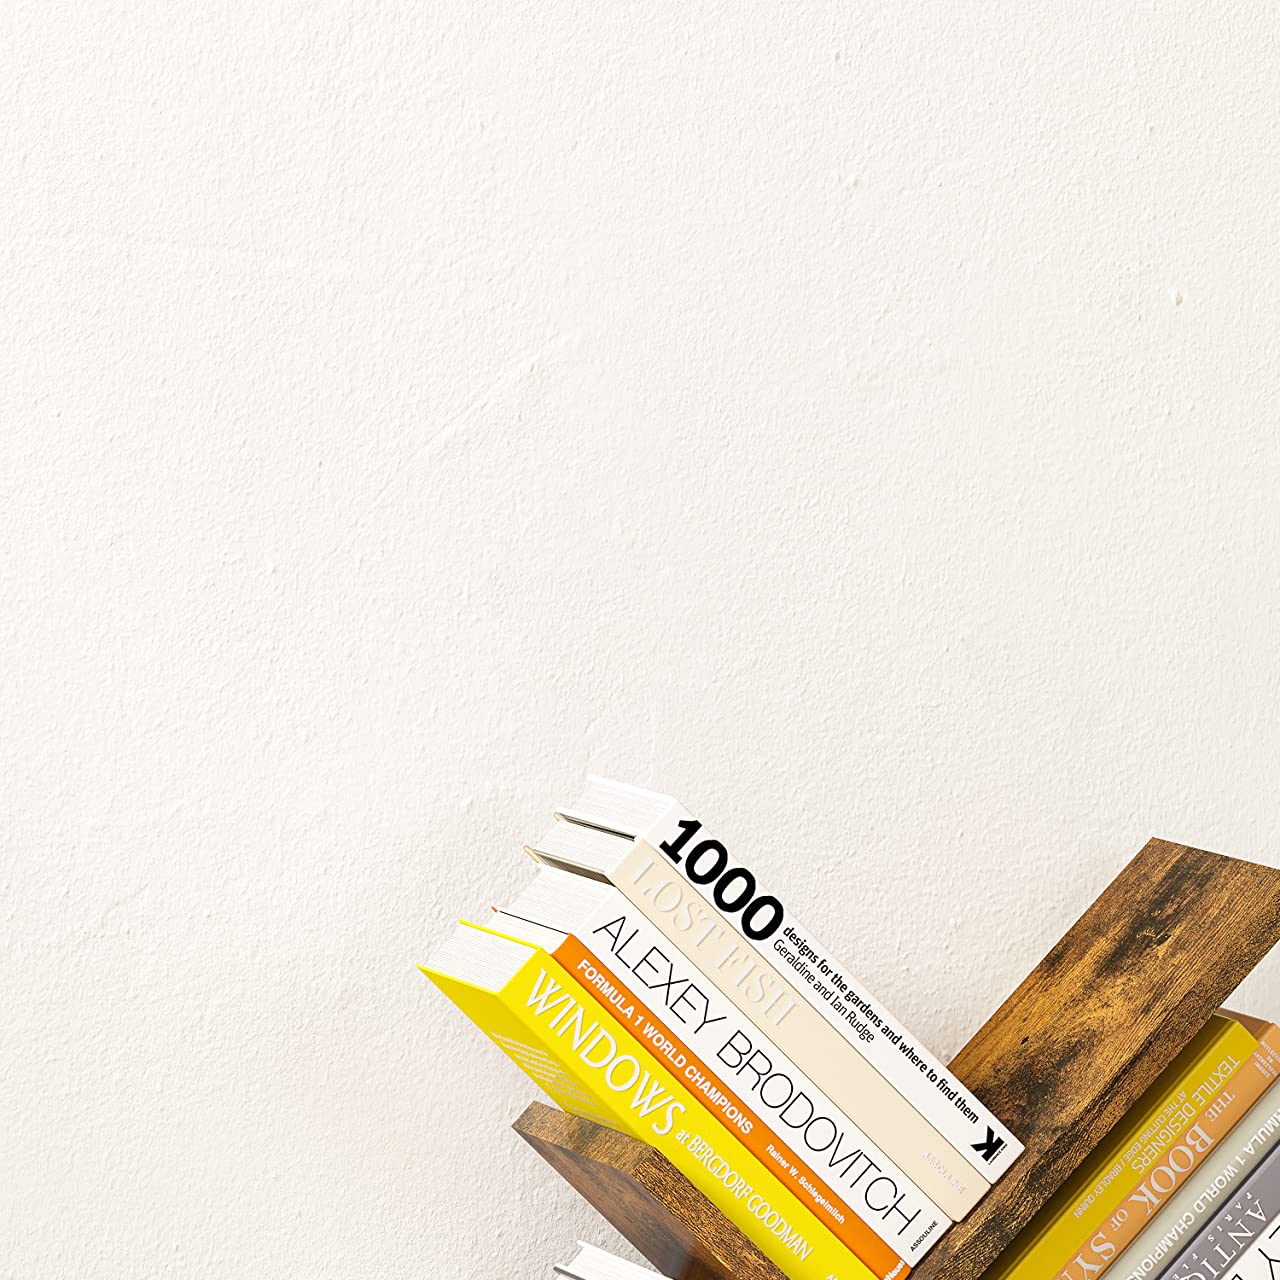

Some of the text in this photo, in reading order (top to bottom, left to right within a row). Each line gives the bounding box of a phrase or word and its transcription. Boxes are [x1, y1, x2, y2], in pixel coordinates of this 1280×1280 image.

[659, 819, 784, 942] 1000
[633, 861, 800, 1027] LOST FISH
[773, 939, 875, 1043] Geraldine and Ian Rudge
[577, 959, 754, 1134] FORMULA 1 WORLD CHAMPIONS
[593, 916, 727, 1034] ALEXEY
[717, 1030, 921, 1235] BRODOVITCH
[783, 926, 979, 1124] designs for the gardens and where to find them
[526, 968, 687, 1135] WINDOWS
[676, 1129, 691, 1144] at
[688, 1136, 752, 1200] BERGDORF
[747, 1195, 813, 1262] GOODMAN
[1073, 1090, 1188, 1219] AT THE CUTTING EDGE BRADLEY QUINN
[1132, 1055, 1240, 1175] TEXTILE DESIGNERS
[1204, 1092, 1236, 1123] THE
[765, 1144, 846, 1225] Rainer W. Schlegelmilch
[1128, 1124, 1215, 1217] BOOK
[1194, 1165, 1239, 1214] WORLD
[1236, 1157, 1246, 1167] 1
[910, 1220, 938, 1251] ASSOULINE
[1110, 1207, 1128, 1232] OF
[1207, 1191, 1253, 1242] PARIS
